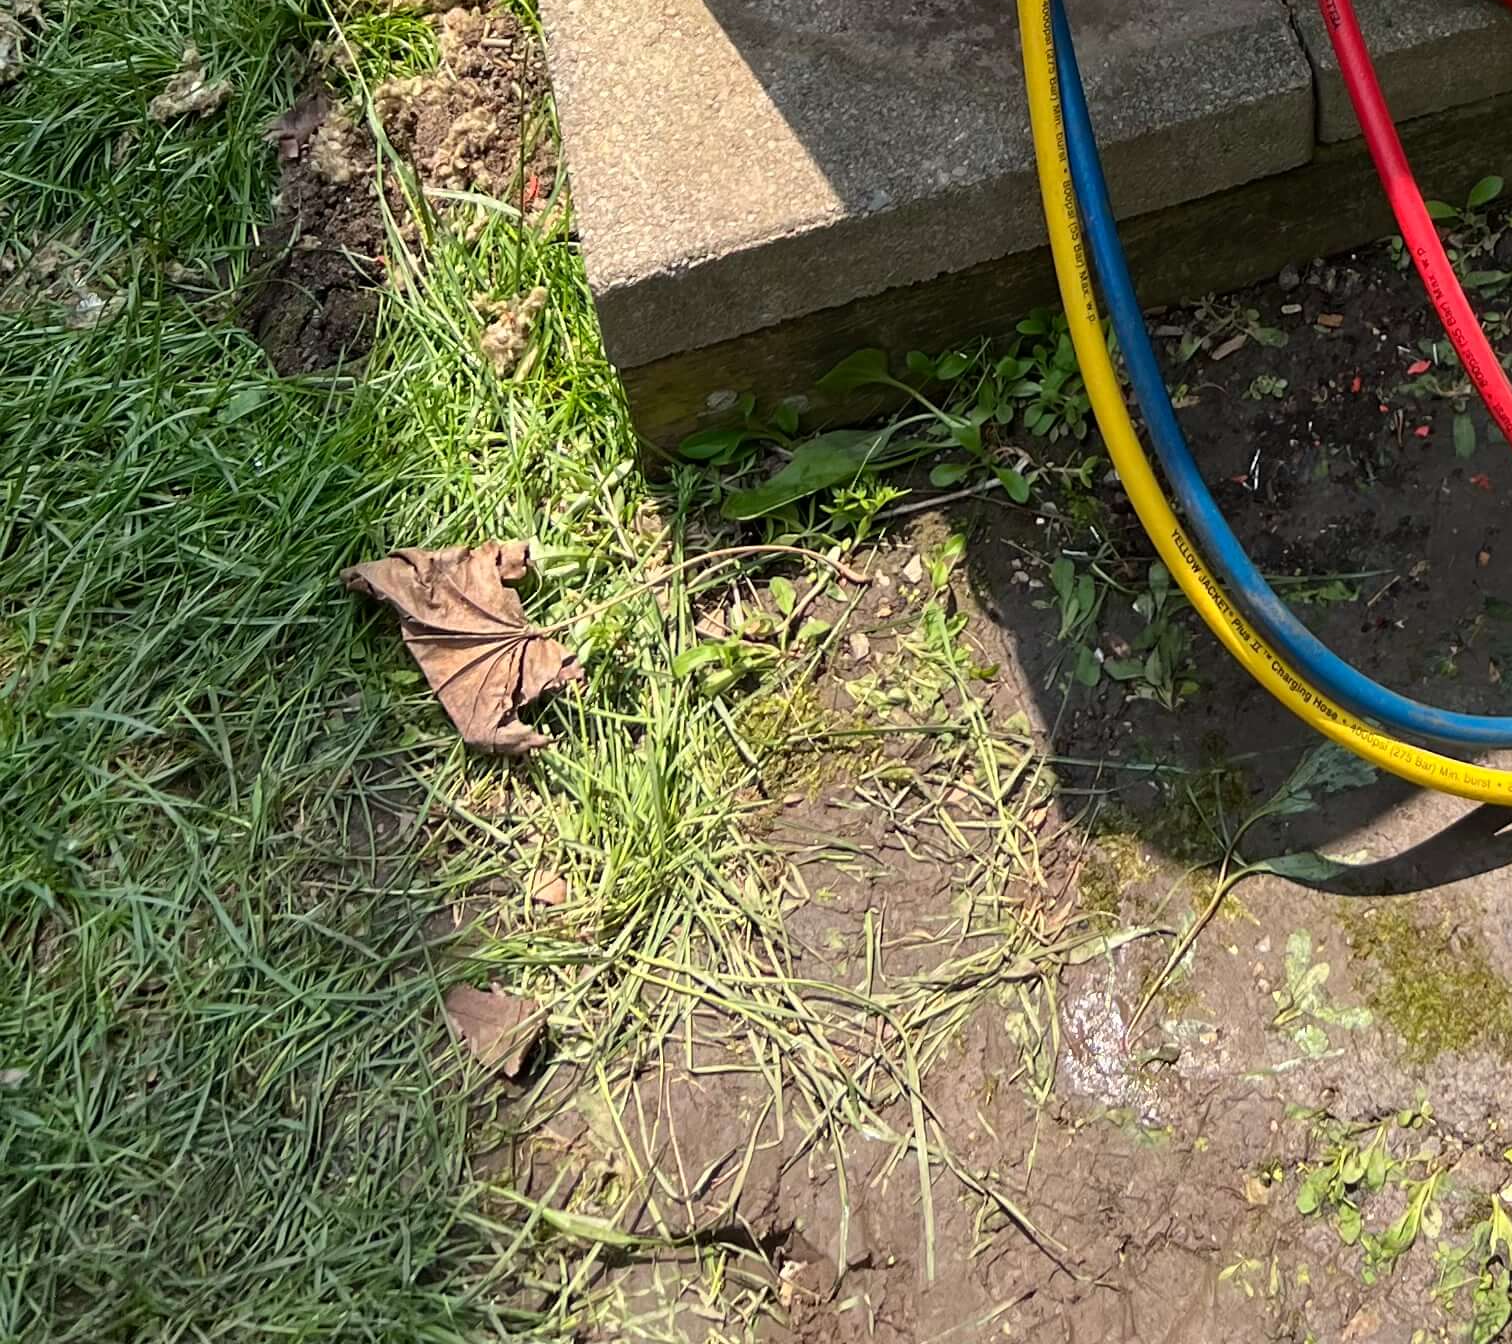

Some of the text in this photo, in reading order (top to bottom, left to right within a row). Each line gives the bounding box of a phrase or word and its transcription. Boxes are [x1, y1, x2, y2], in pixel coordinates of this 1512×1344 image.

[1049, 77, 1059, 101] Bar)
[1055, 131, 1067, 163] burst
[1067, 221, 1079, 241] (55
[1073, 243, 1085, 269] Bar)
[1439, 301, 1457, 328] Bar)
[1451, 326, 1468, 347] (55
[1170, 527, 1201, 575] YELLOW
[1231, 618, 1250, 642] Plus
[1250, 641, 1263, 654] II
[1270, 659, 1313, 704] Charging
[1312, 695, 1339, 721] Hose
[1349, 722, 1387, 752] 4000psi
[1389, 746, 1413, 764] (275
[1414, 756, 1438, 774] Bar)
[1439, 765, 1460, 780] Min.
[1463, 772, 1492, 789] burst
